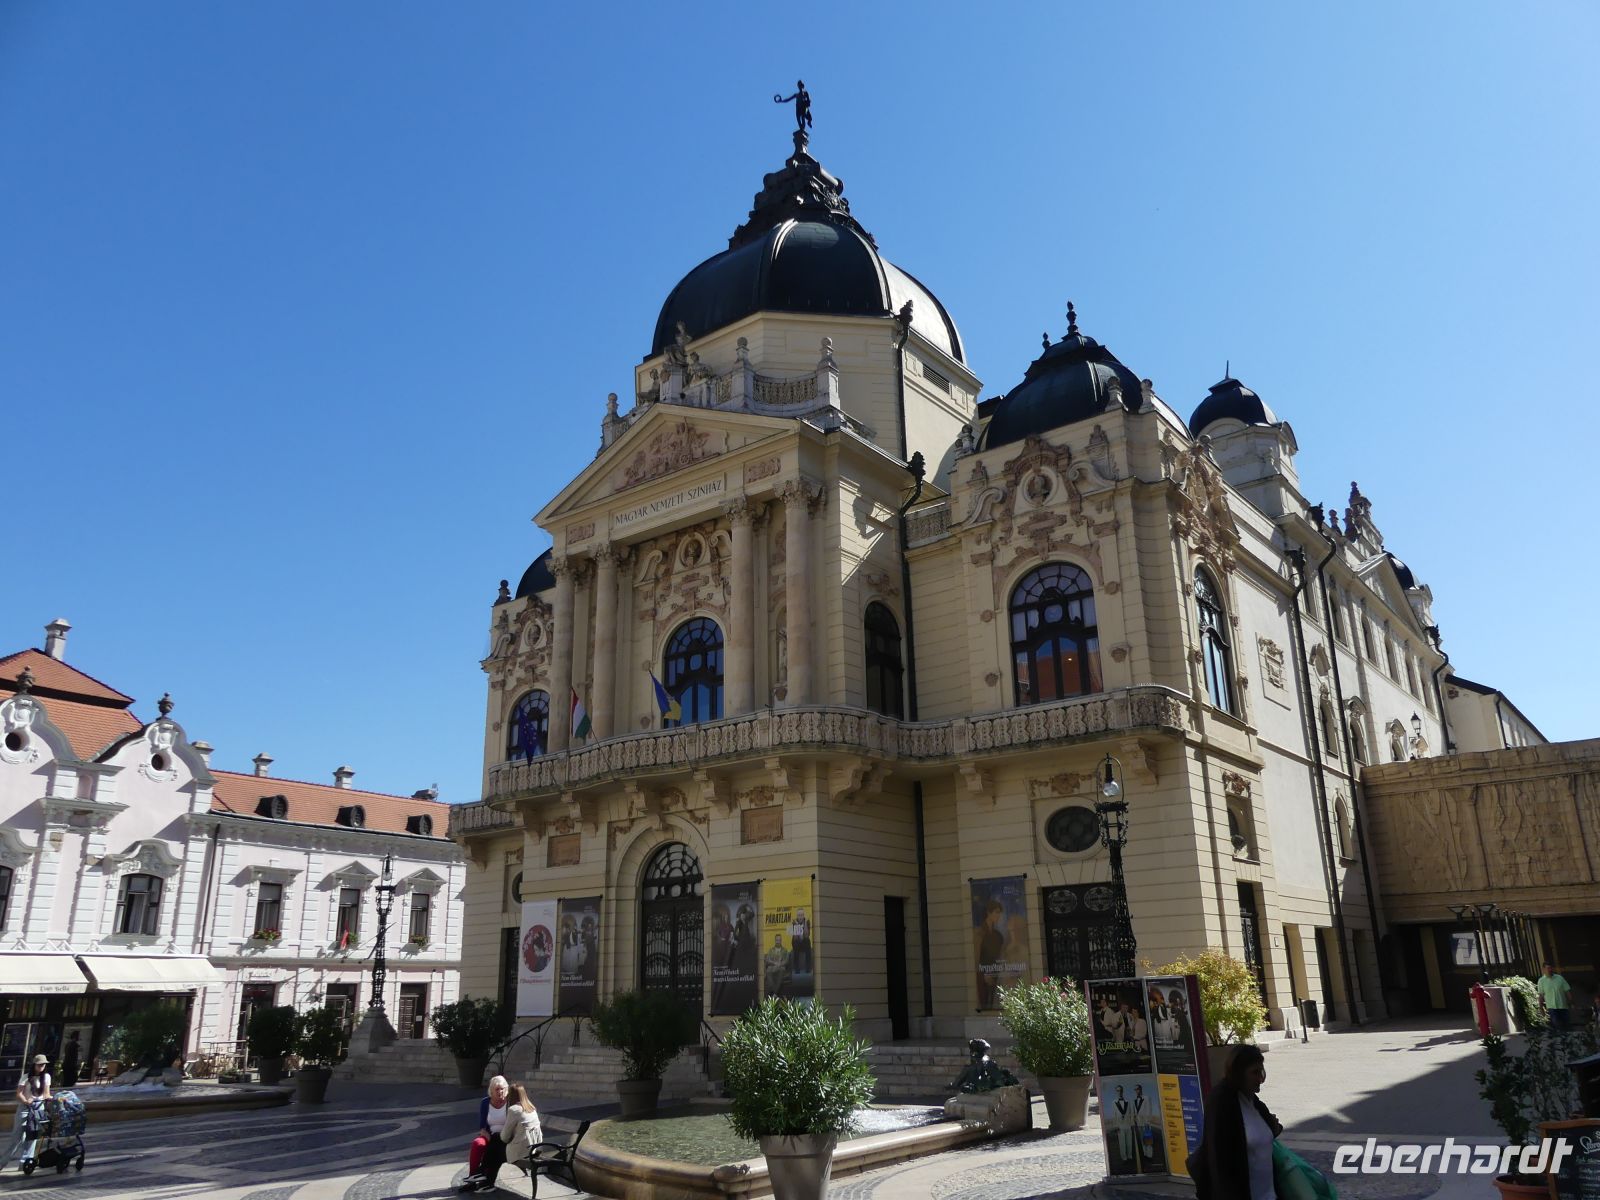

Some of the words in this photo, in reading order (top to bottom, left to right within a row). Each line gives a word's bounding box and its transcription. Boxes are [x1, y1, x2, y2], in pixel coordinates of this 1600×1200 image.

[615, 505, 648, 526] MAGYAR
[650, 493, 684, 513] NEMZETI
[687, 480, 722, 501] SZÍNHÁZ
